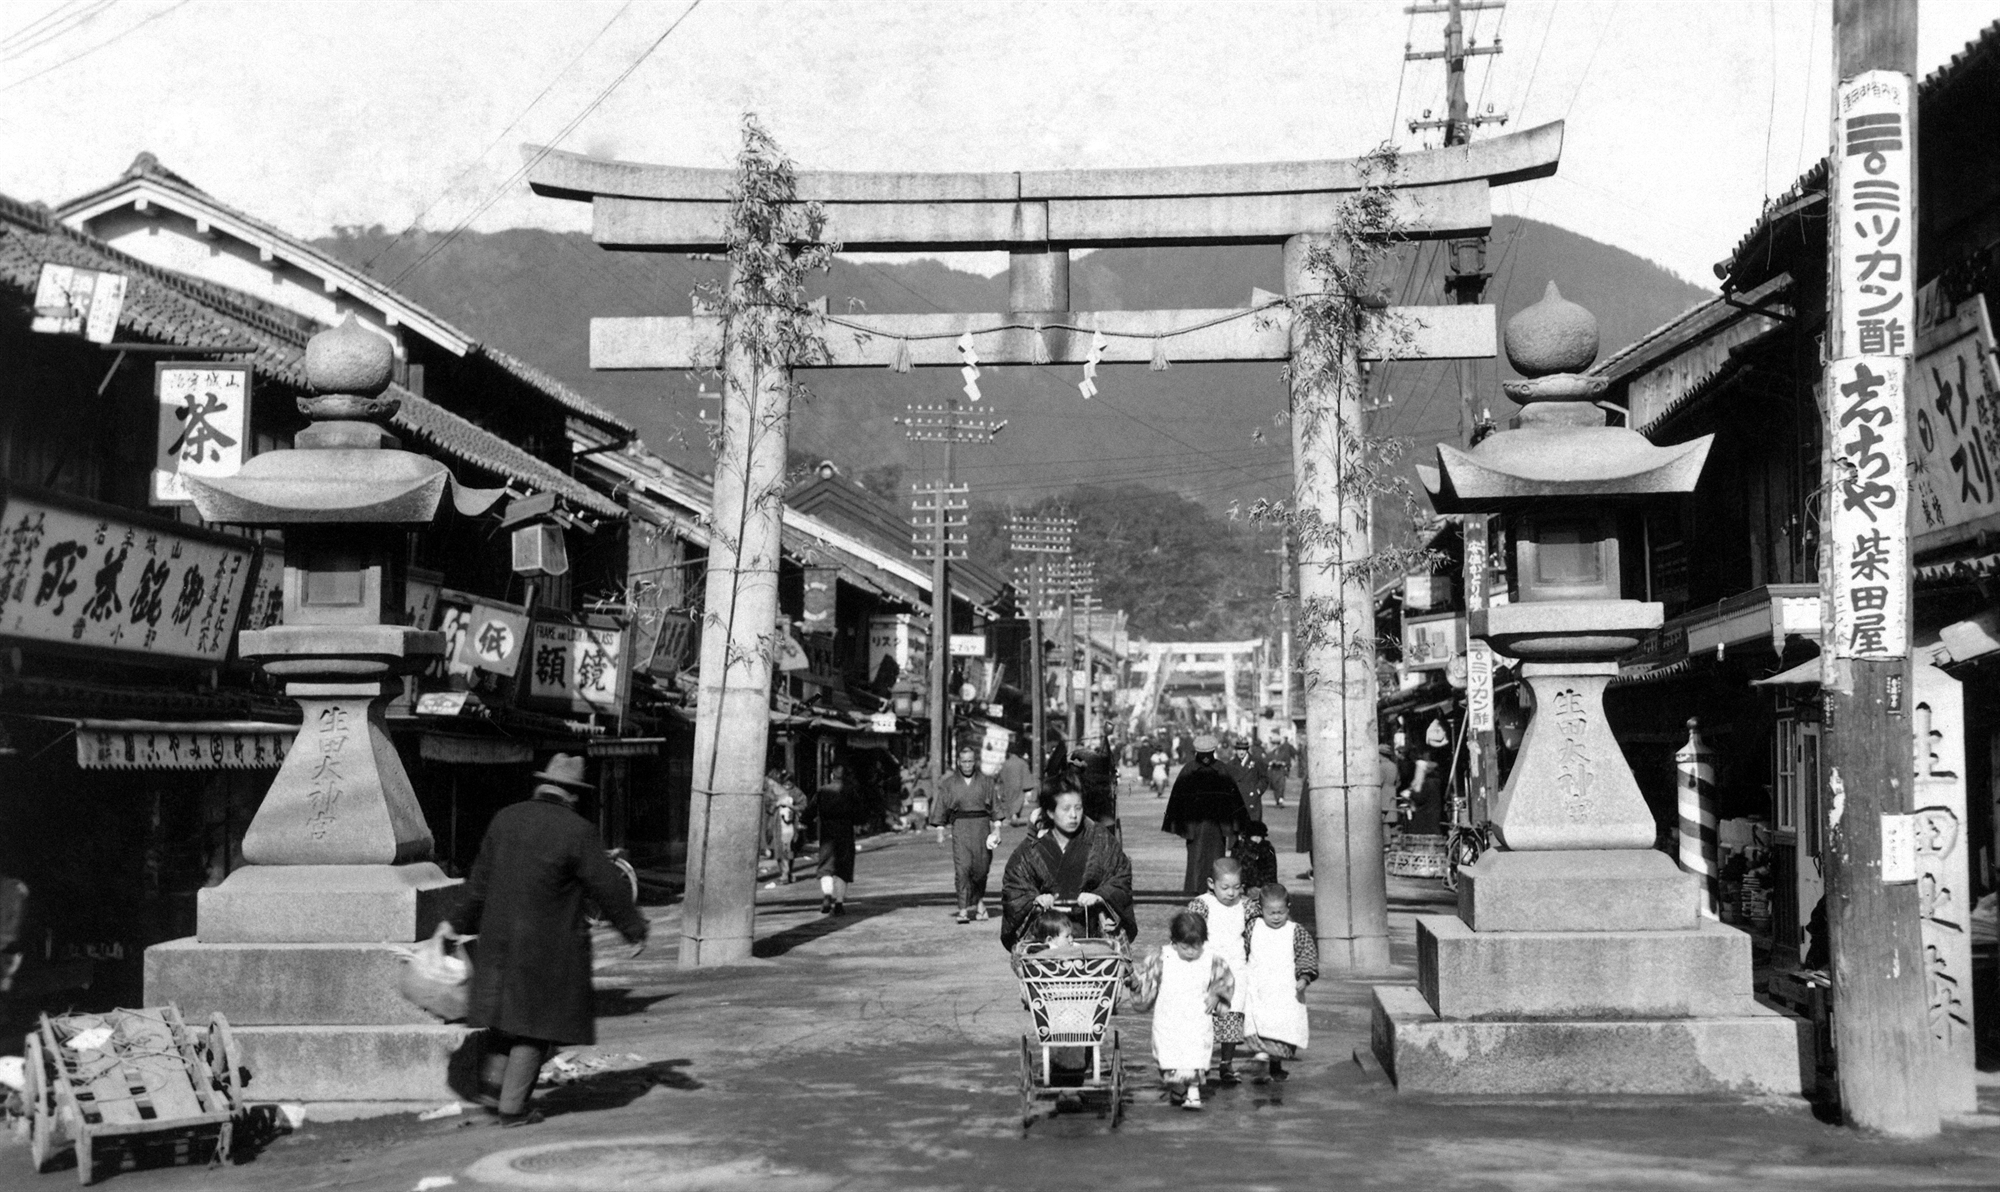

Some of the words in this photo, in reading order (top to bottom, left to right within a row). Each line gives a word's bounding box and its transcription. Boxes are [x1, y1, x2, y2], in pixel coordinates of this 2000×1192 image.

[1853, 179, 1905, 355] ミツカン酢
[167, 391, 238, 465] 茶
[1850, 527, 1892, 655] 柴田屋
[535, 643, 568, 689] 額
[577, 649, 608, 691] 鏡
